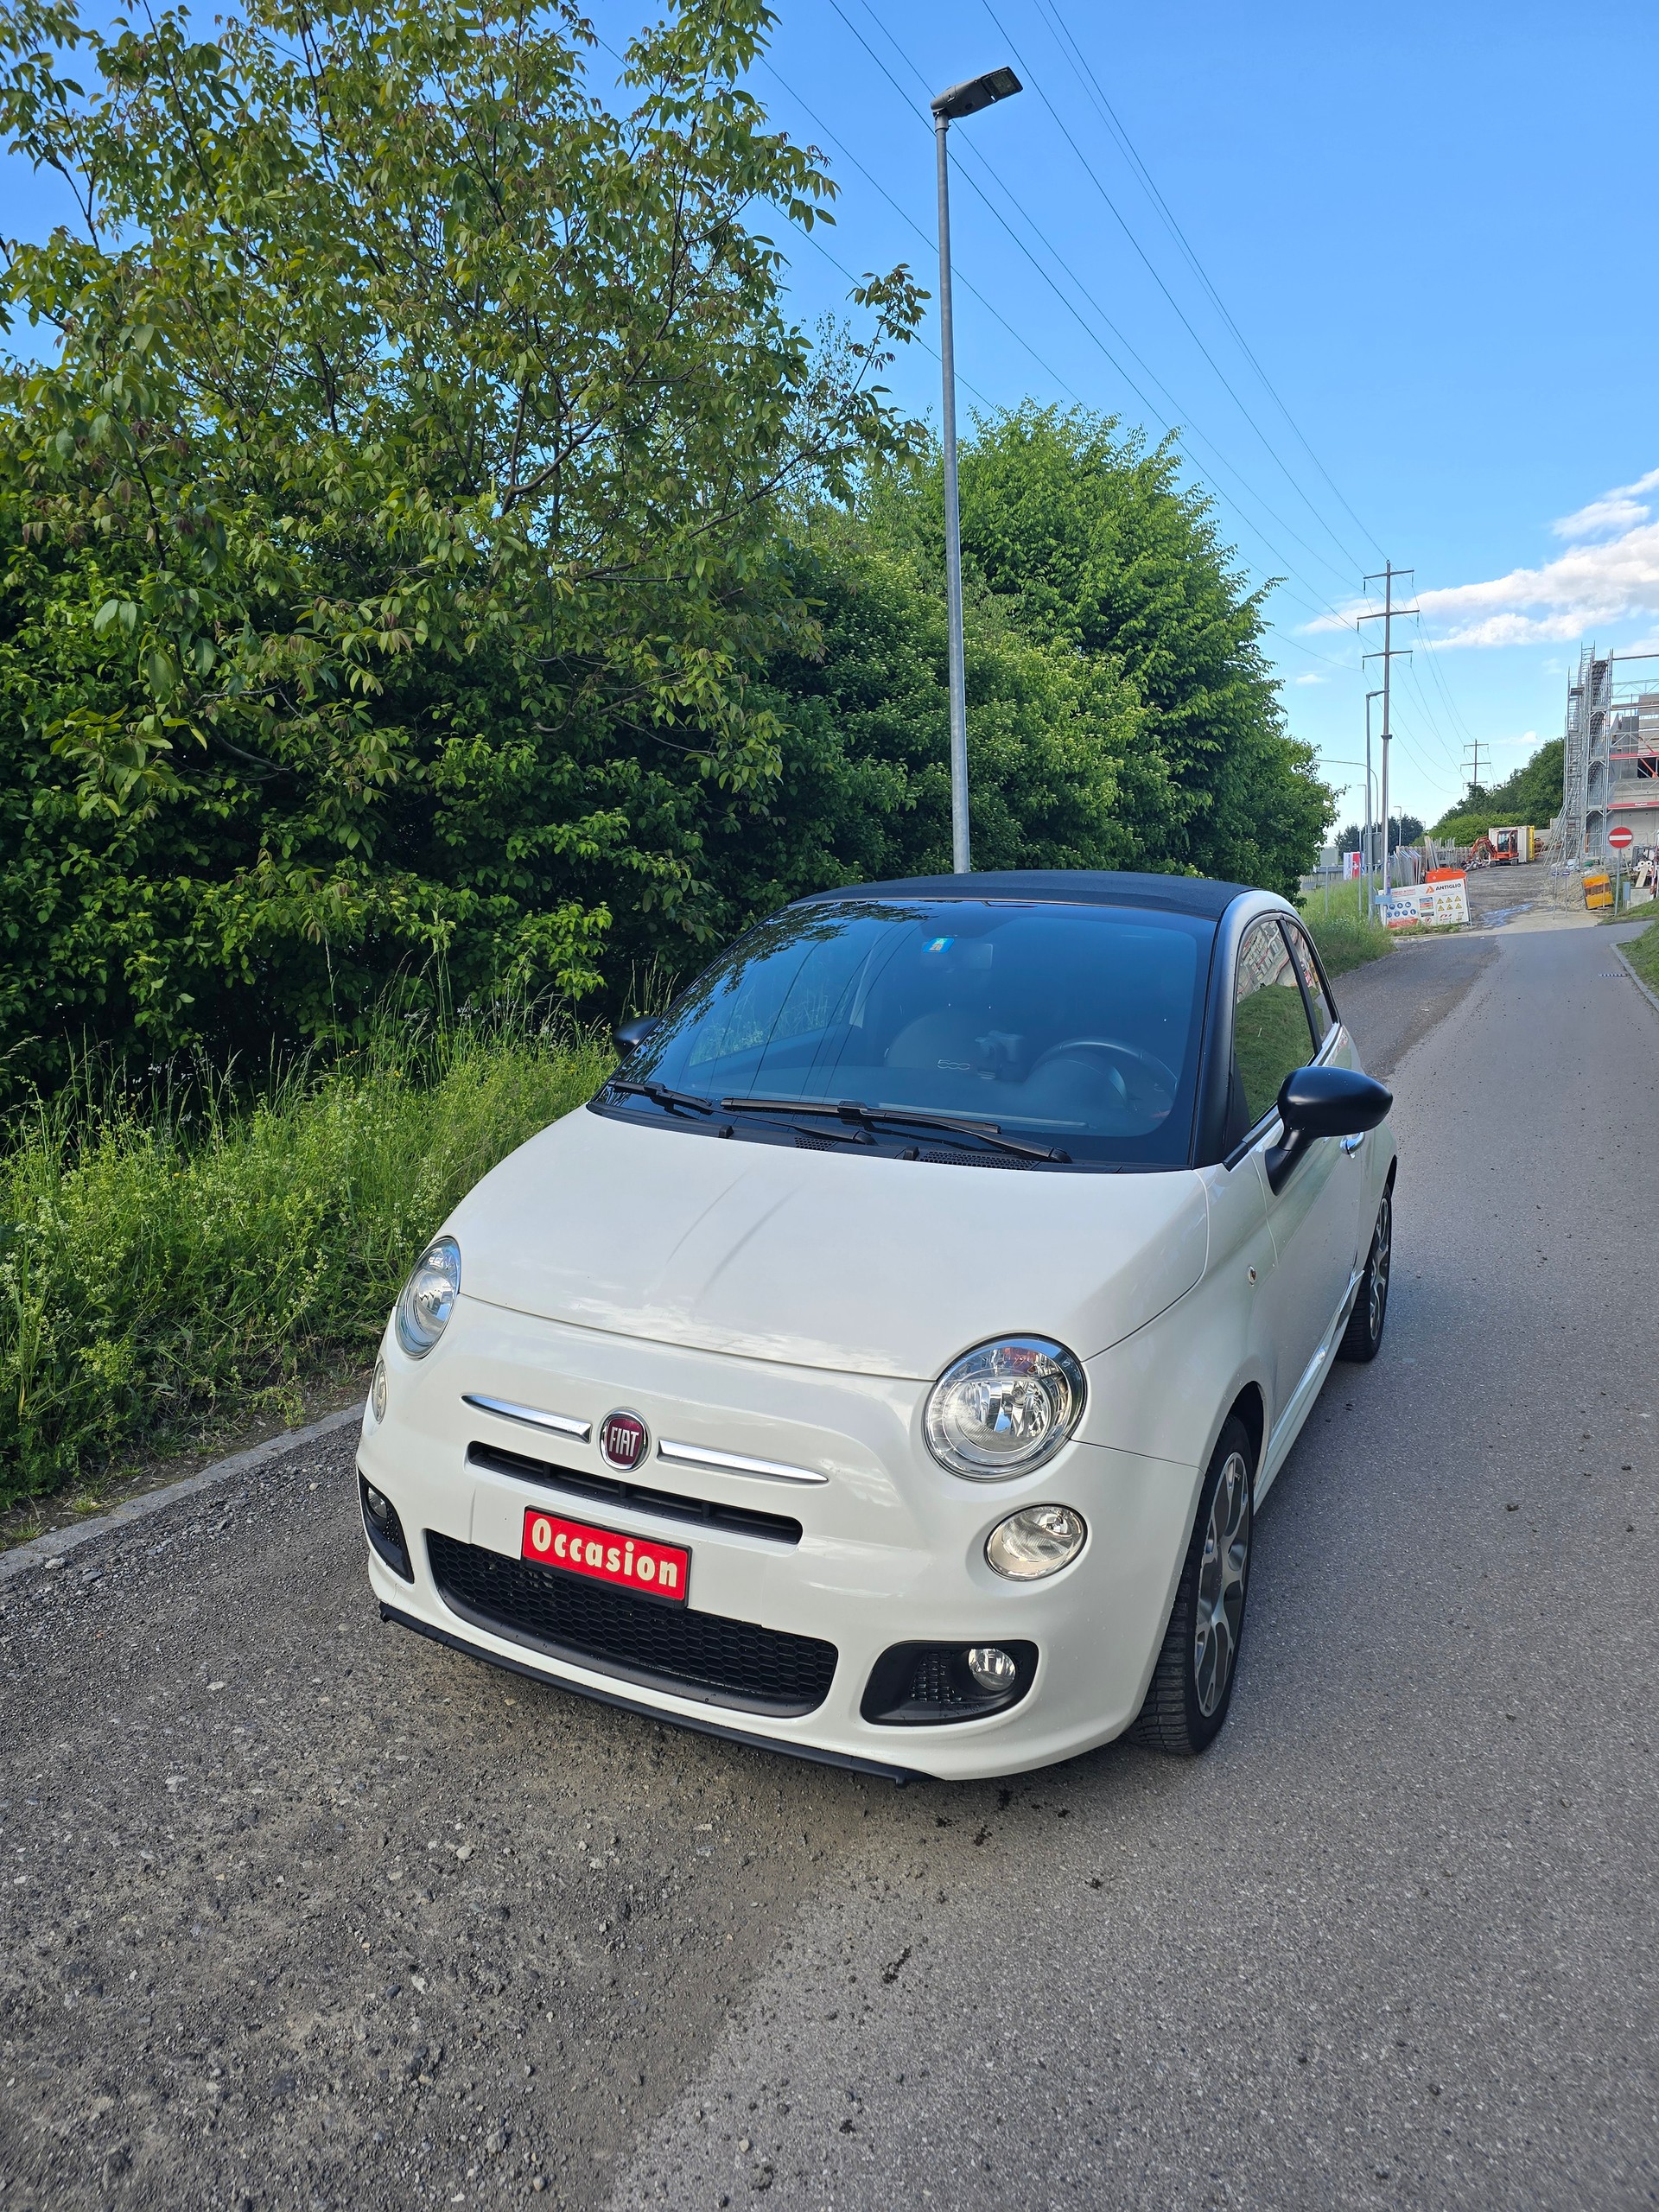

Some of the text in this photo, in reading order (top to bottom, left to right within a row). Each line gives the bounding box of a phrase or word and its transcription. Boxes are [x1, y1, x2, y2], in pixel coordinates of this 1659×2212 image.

[938, 1059, 971, 1071] 500
[608, 1426, 639, 1458] FIAT
[531, 1517, 678, 1588] Occasion
